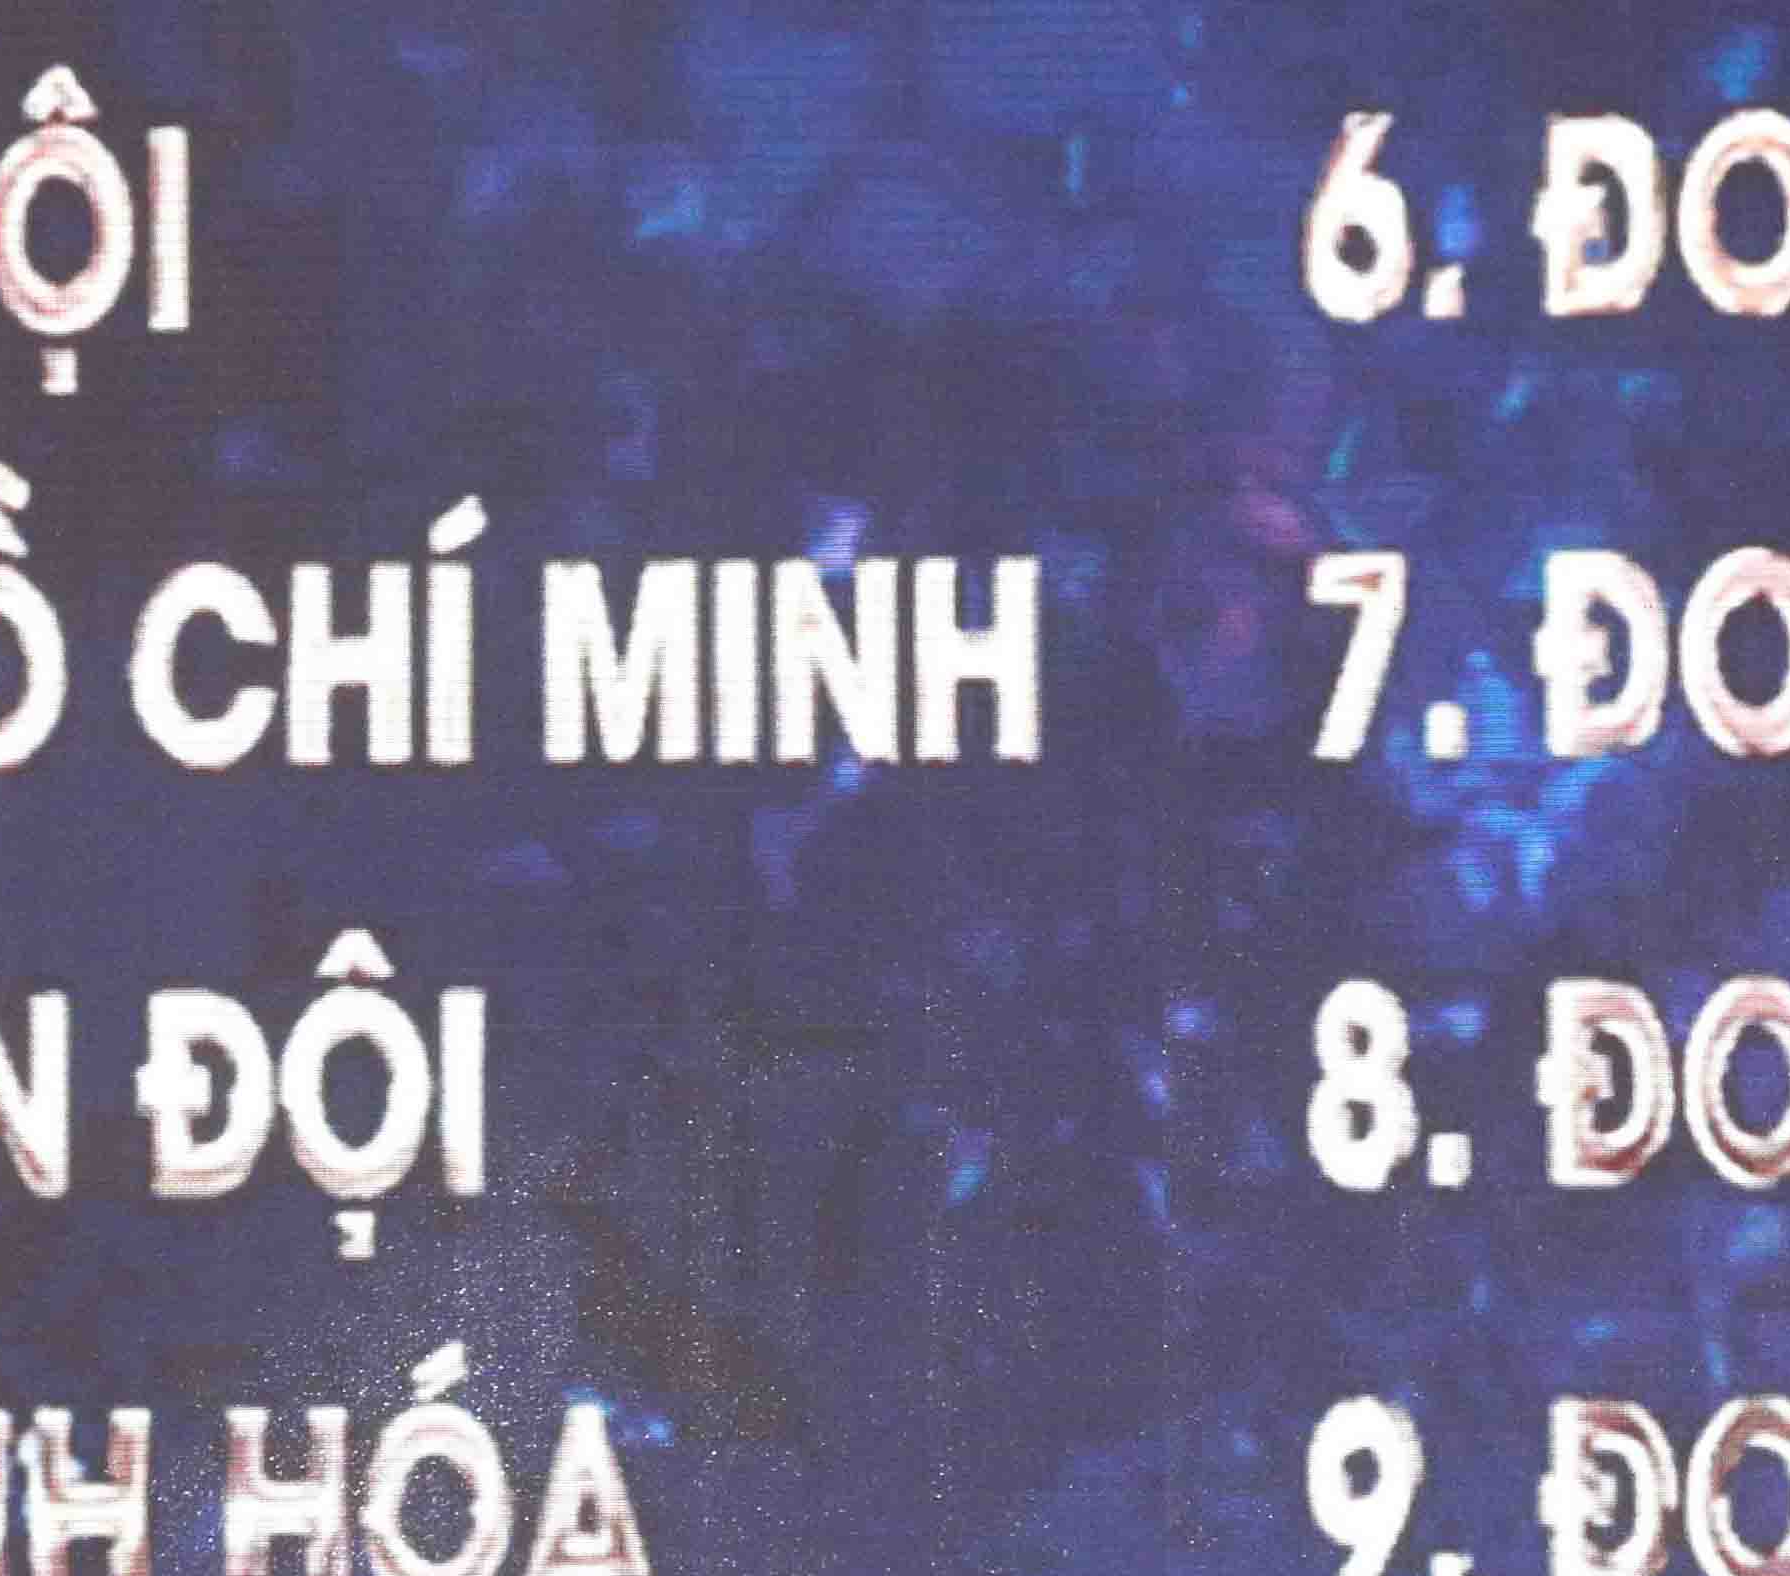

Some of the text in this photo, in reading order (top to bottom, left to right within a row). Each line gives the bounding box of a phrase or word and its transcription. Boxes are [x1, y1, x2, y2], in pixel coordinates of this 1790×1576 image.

[1303, 111, 1466, 321] 6.
[129, 494, 488, 774] CHÍ
[542, 557, 1043, 766] MINH
[1303, 551, 1468, 761] 7.
[135, 929, 486, 1258] ĐỘI
[1306, 983, 1471, 1189] 8.
